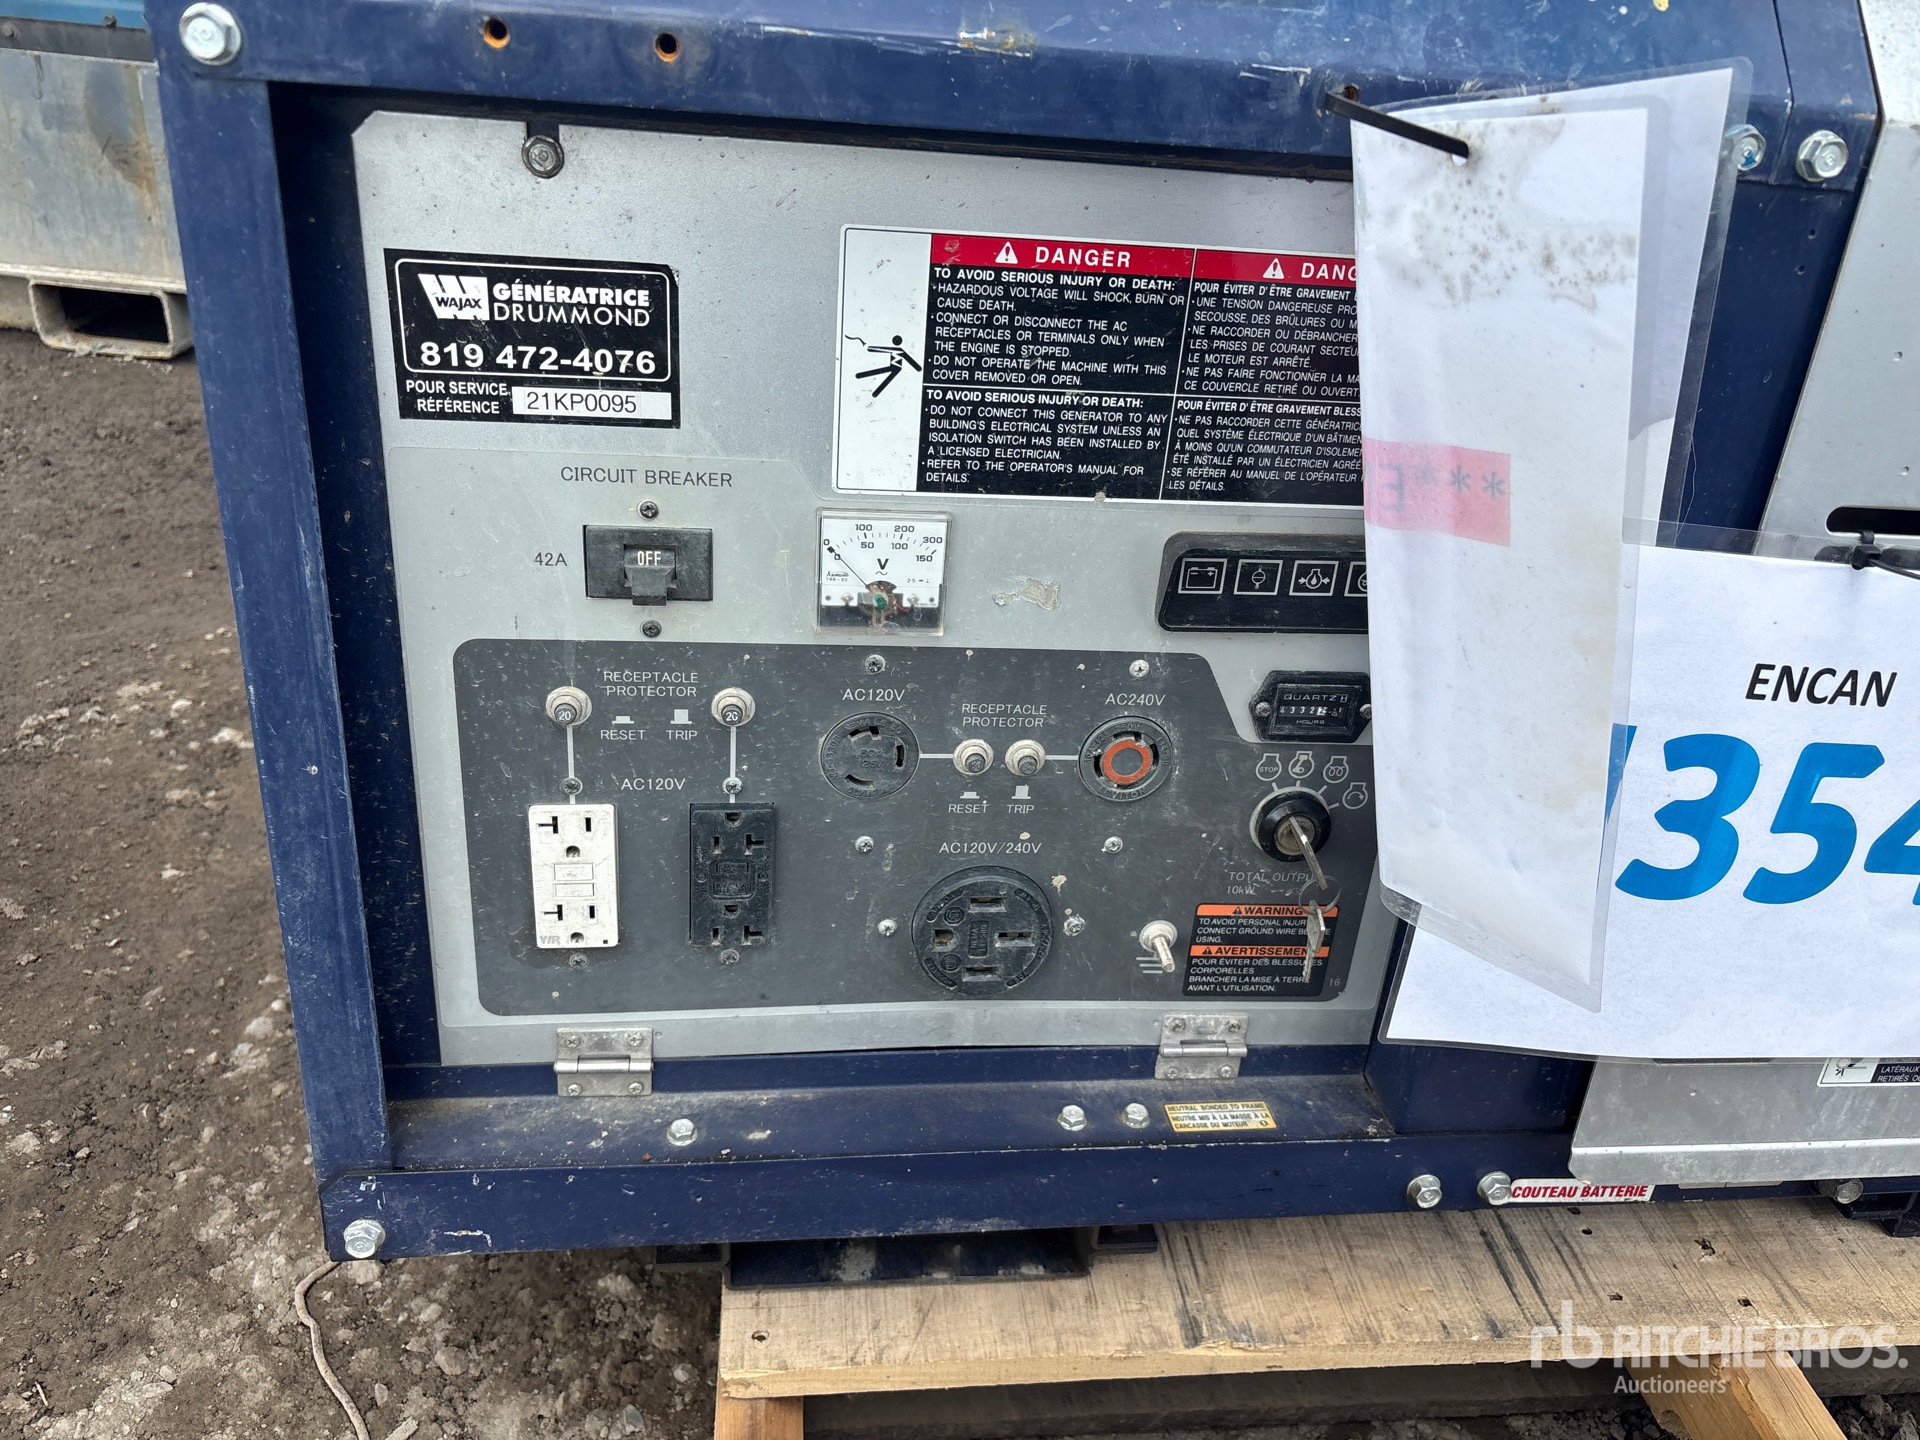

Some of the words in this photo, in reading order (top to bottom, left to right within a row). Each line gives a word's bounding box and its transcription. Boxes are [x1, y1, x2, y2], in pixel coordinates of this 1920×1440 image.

[1035, 246, 1131, 267] DANGER
[934, 267, 950, 278] TO
[957, 269, 995, 281] AVOID
[1001, 271, 1054, 284] SERIOUS
[1060, 274, 1102, 286] INJURY
[1108, 276, 1126, 287] OR
[1132, 278, 1175, 290] DEATH:
[493, 279, 649, 307] GÉNÉRATRICE
[938, 282, 1004, 296] HAZARDOUS
[1010, 286, 1058, 299] VOLTAGE
[1064, 289, 1088, 301] WILL
[1093, 291, 1131, 304] SHOCK,
[1135, 294, 1166, 304] BURN
[1169, 295, 1184, 305] OR
[1194, 282, 1220, 293] POUR
[1224, 282, 1254, 295] ÉVITER
[1259, 286, 1268, 295] D'
[1269, 284, 1292, 297] ÊTRE
[1296, 288, 1350, 301] GRAVEMENT
[436, 296, 482, 310] WAJAX
[937, 297, 974, 309] CAUSE
[979, 300, 1016, 311] DEATH.
[1196, 297, 1216, 307] UNE
[1222, 298, 1263, 310] TENSION
[1268, 301, 1333, 314] DANGEREUSE
[494, 302, 650, 327] DRUMMOND
[936, 312, 988, 325] CONNECT
[993, 315, 1009, 326] OR
[1014, 316, 1081, 329] DISCONNECT
[1088, 319, 1108, 330] THE
[1113, 320, 1127, 331] AC
[420, 341, 483, 367] 819
[496, 345, 656, 374] 472-4076
[1188, 353, 1200, 363] LE
[1204, 354, 1245, 364] MOTEUR
[1250, 354, 1268, 366] EST
[1272, 355, 1311, 368] ARRÊTÉ.
[406, 380, 446, 394] POUR
[449, 382, 507, 396] SERVICE
[417, 398, 499, 414] RÉFÉRENCE
[527, 392, 637, 413] 21KP0095
[930, 419, 985, 430] BUILDING'S
[991, 421, 1052, 433] ELECTRICAL
[1057, 424, 1098, 435] SYSTEM
[1103, 425, 1141, 436] UNLESS
[1147, 427, 1161, 436] AN
[928, 447, 935, 455] A
[939, 447, 989, 457] LICENSED
[995, 449, 1061, 460] ELECTRICIAN.
[1173, 453, 1189, 464] ÉTÉ
[1194, 453, 1232, 466] INSTALLÉ
[1237, 456, 1254, 466] PAR
[1259, 457, 1270, 466] UN
[1275, 456, 1328, 469] ÉLECTRICIEN
[560, 467, 637, 483] CIRCUIT
[645, 469, 732, 487] BREAKER
[926, 473, 970, 483] DETAILS.
[1171, 467, 1182, 477] SE
[1187, 466, 1226, 478] RÉFÉRER
[1230, 469, 1243, 479] AU
[1246, 469, 1280, 480] MANUEL
[1284, 471, 1296, 480] DE
[1300, 470, 1357, 483] L'OPÉRATEUR
[1169, 481, 1184, 490] LES
[1189, 479, 1225, 491] DÉTAILS.
[534, 552, 567, 567] 42A
[637, 551, 661, 566] OFF
[877, 558, 889, 570] V
[603, 671, 699, 683] RECEPTACLE
[606, 685, 696, 697] PROTECTOR
[1745, 662, 1897, 708] ENCAN
[842, 688, 905, 702] AC120V
[1105, 693, 1166, 706] AC240V
[961, 703, 1047, 715] RECEPTACLE
[558, 711, 571, 721] 20
[725, 711, 738, 722] 20
[962, 716, 1044, 728] PROTECTOR
[601, 730, 646, 740] RESET
[666, 730, 697, 740] TRIP
[621, 778, 686, 791] AC120V
[948, 803, 989, 814] RESET
[1006, 804, 1034, 814] TRIP
[938, 842, 1042, 855] AC120V/240V
[1229, 872, 1267, 882] TOTAL
[1273, 873, 1315, 882] OUTPU
[1226, 886, 1255, 895] 10kW
[1244, 907, 1303, 916] WARNING
[1211, 918, 1236, 926] AVOID
[1237, 918, 1281, 926] PERSONAL
[1283, 919, 1309, 927] INJUR
[1196, 935, 1222, 943] USING.
[1215, 947, 1311, 955] AVERTISSEMEN
[1219, 957, 1250, 965] ÉVITER
[1252, 958, 1270, 966] DES
[1274, 974, 1280, 983] À
[1329, 978, 1340, 986] 16
[1512, 1187, 1578, 1198] COUTEAU
[1580, 1186, 1648, 1198] BATTERIE
